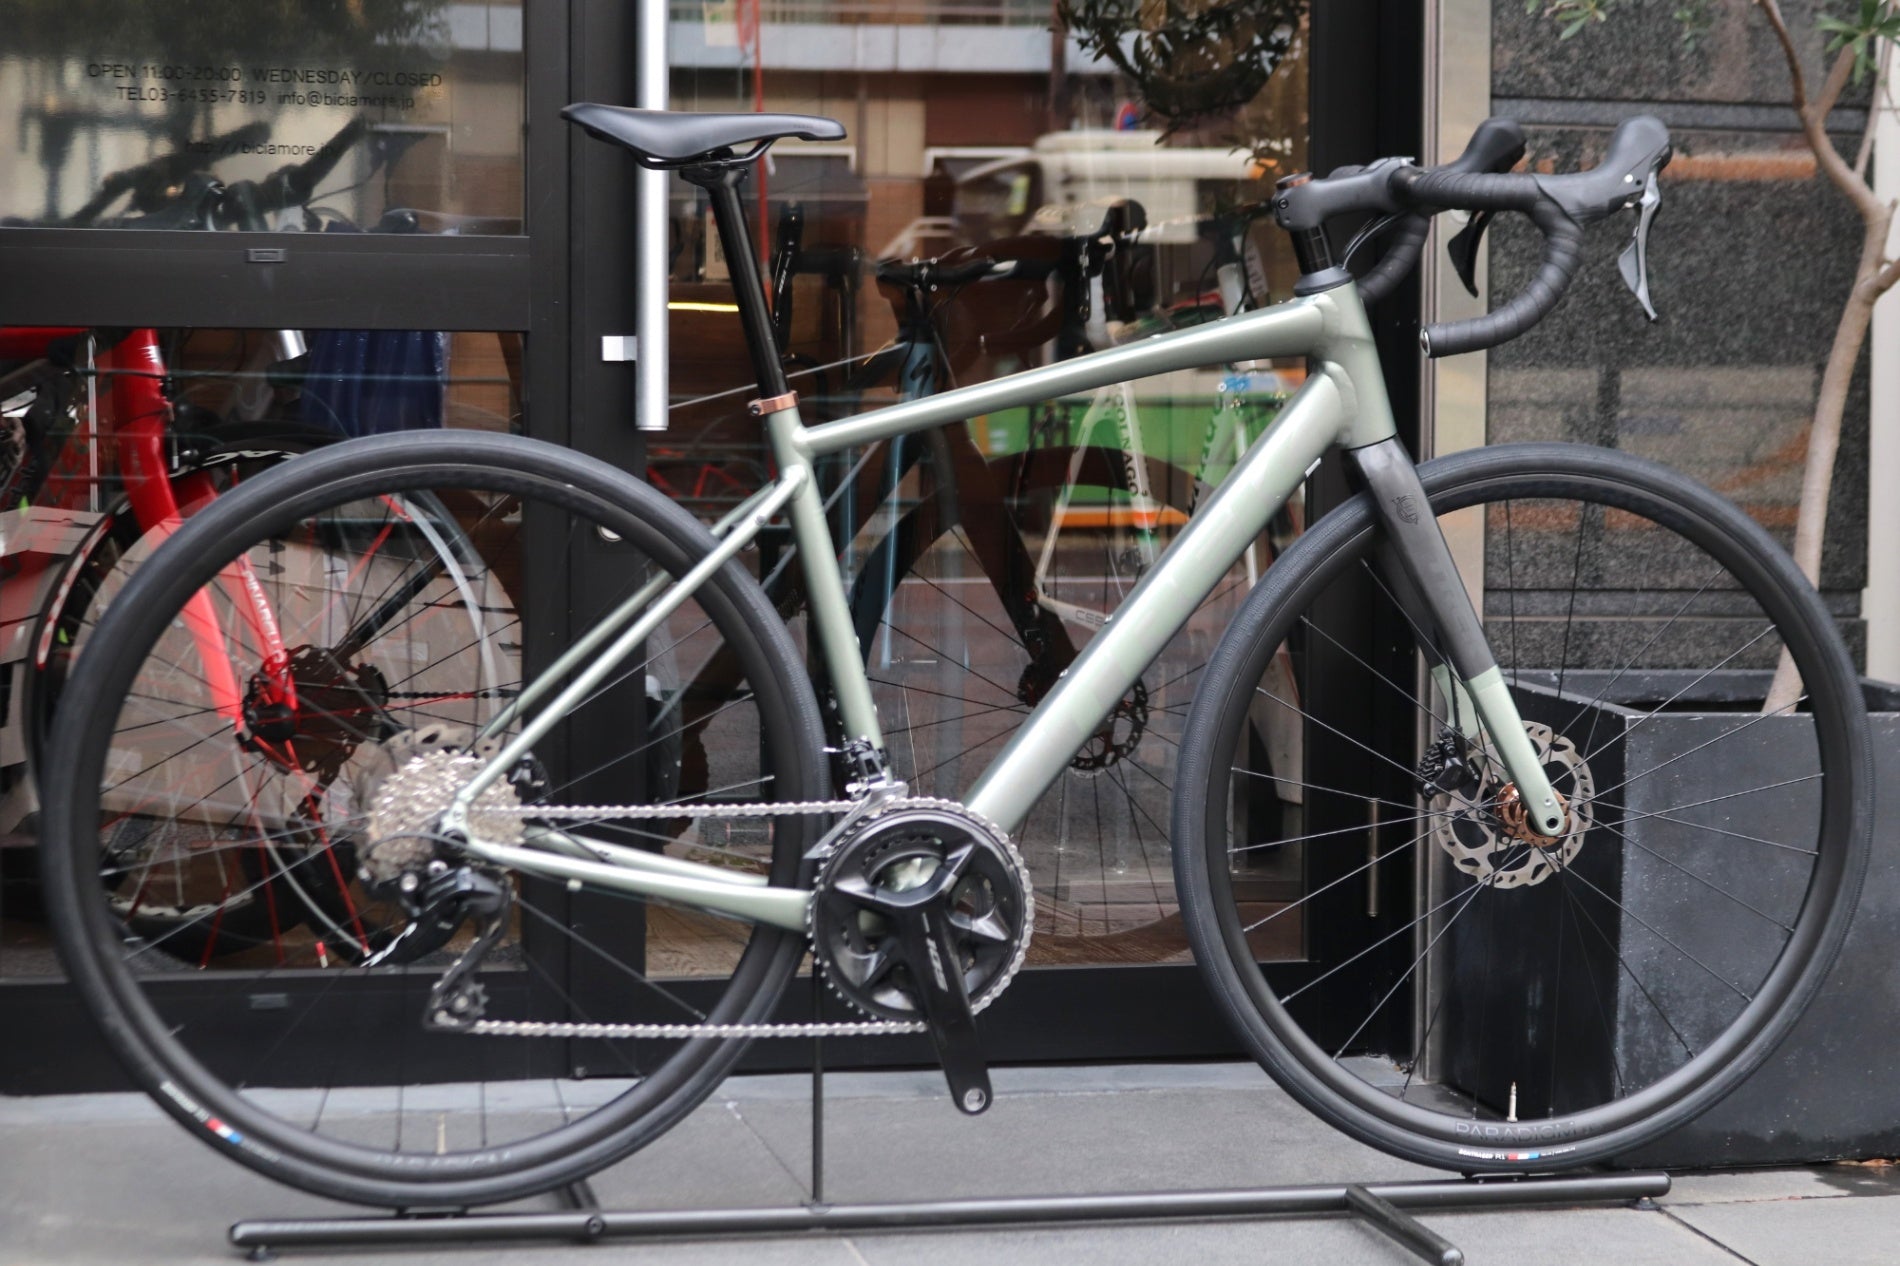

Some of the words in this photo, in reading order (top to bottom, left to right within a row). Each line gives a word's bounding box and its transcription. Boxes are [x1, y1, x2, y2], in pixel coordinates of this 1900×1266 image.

[87, 63, 137, 79] OPEN
[142, 65, 242, 82] 11:00-20:00
[252, 68, 442, 87] WEDNESDAY/CLOSED
[116, 86, 267, 104] TEL03-6455-7819
